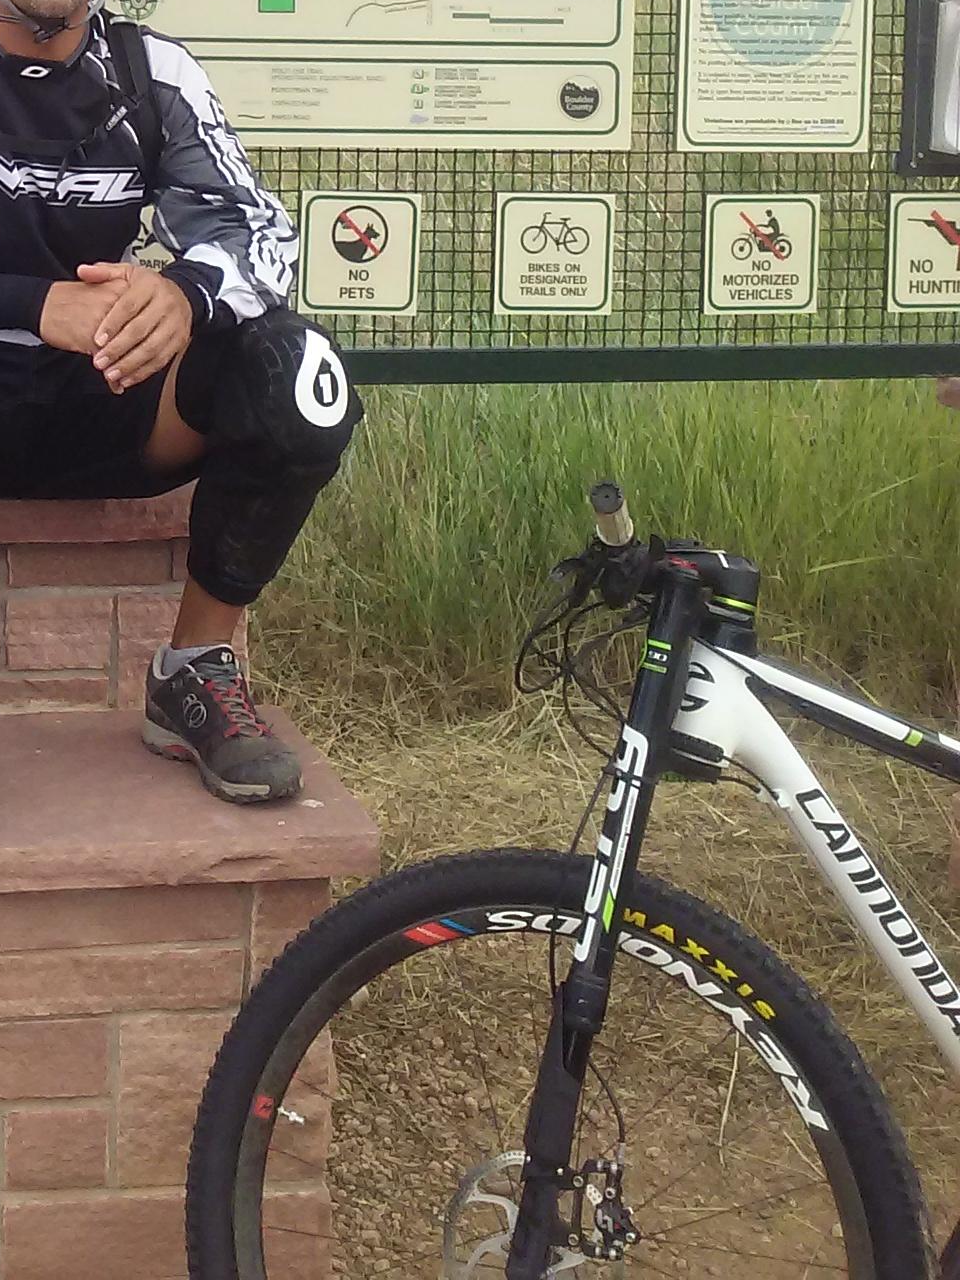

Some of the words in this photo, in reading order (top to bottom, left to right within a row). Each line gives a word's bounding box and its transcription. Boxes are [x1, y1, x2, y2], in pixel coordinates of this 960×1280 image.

[564, 94, 595, 105] Boulder
[566, 102, 594, 113] County
[139, 258, 169, 271] PARK
[527, 262, 558, 274] BIKES
[563, 262, 581, 274] ON
[752, 259, 771, 271] NO
[909, 259, 933, 273] NO
[348, 268, 370, 283] NO
[519, 274, 588, 286] DESIGNATED
[722, 274, 800, 287] MOTORIZED
[339, 286, 376, 301] PETS
[519, 285, 555, 297] TRAILS
[560, 286, 588, 298] ONLY
[729, 288, 793, 301] VEHICLES
[623, 907, 777, 1020] MAXXIS
[486, 910, 830, 1132] REYNODS
